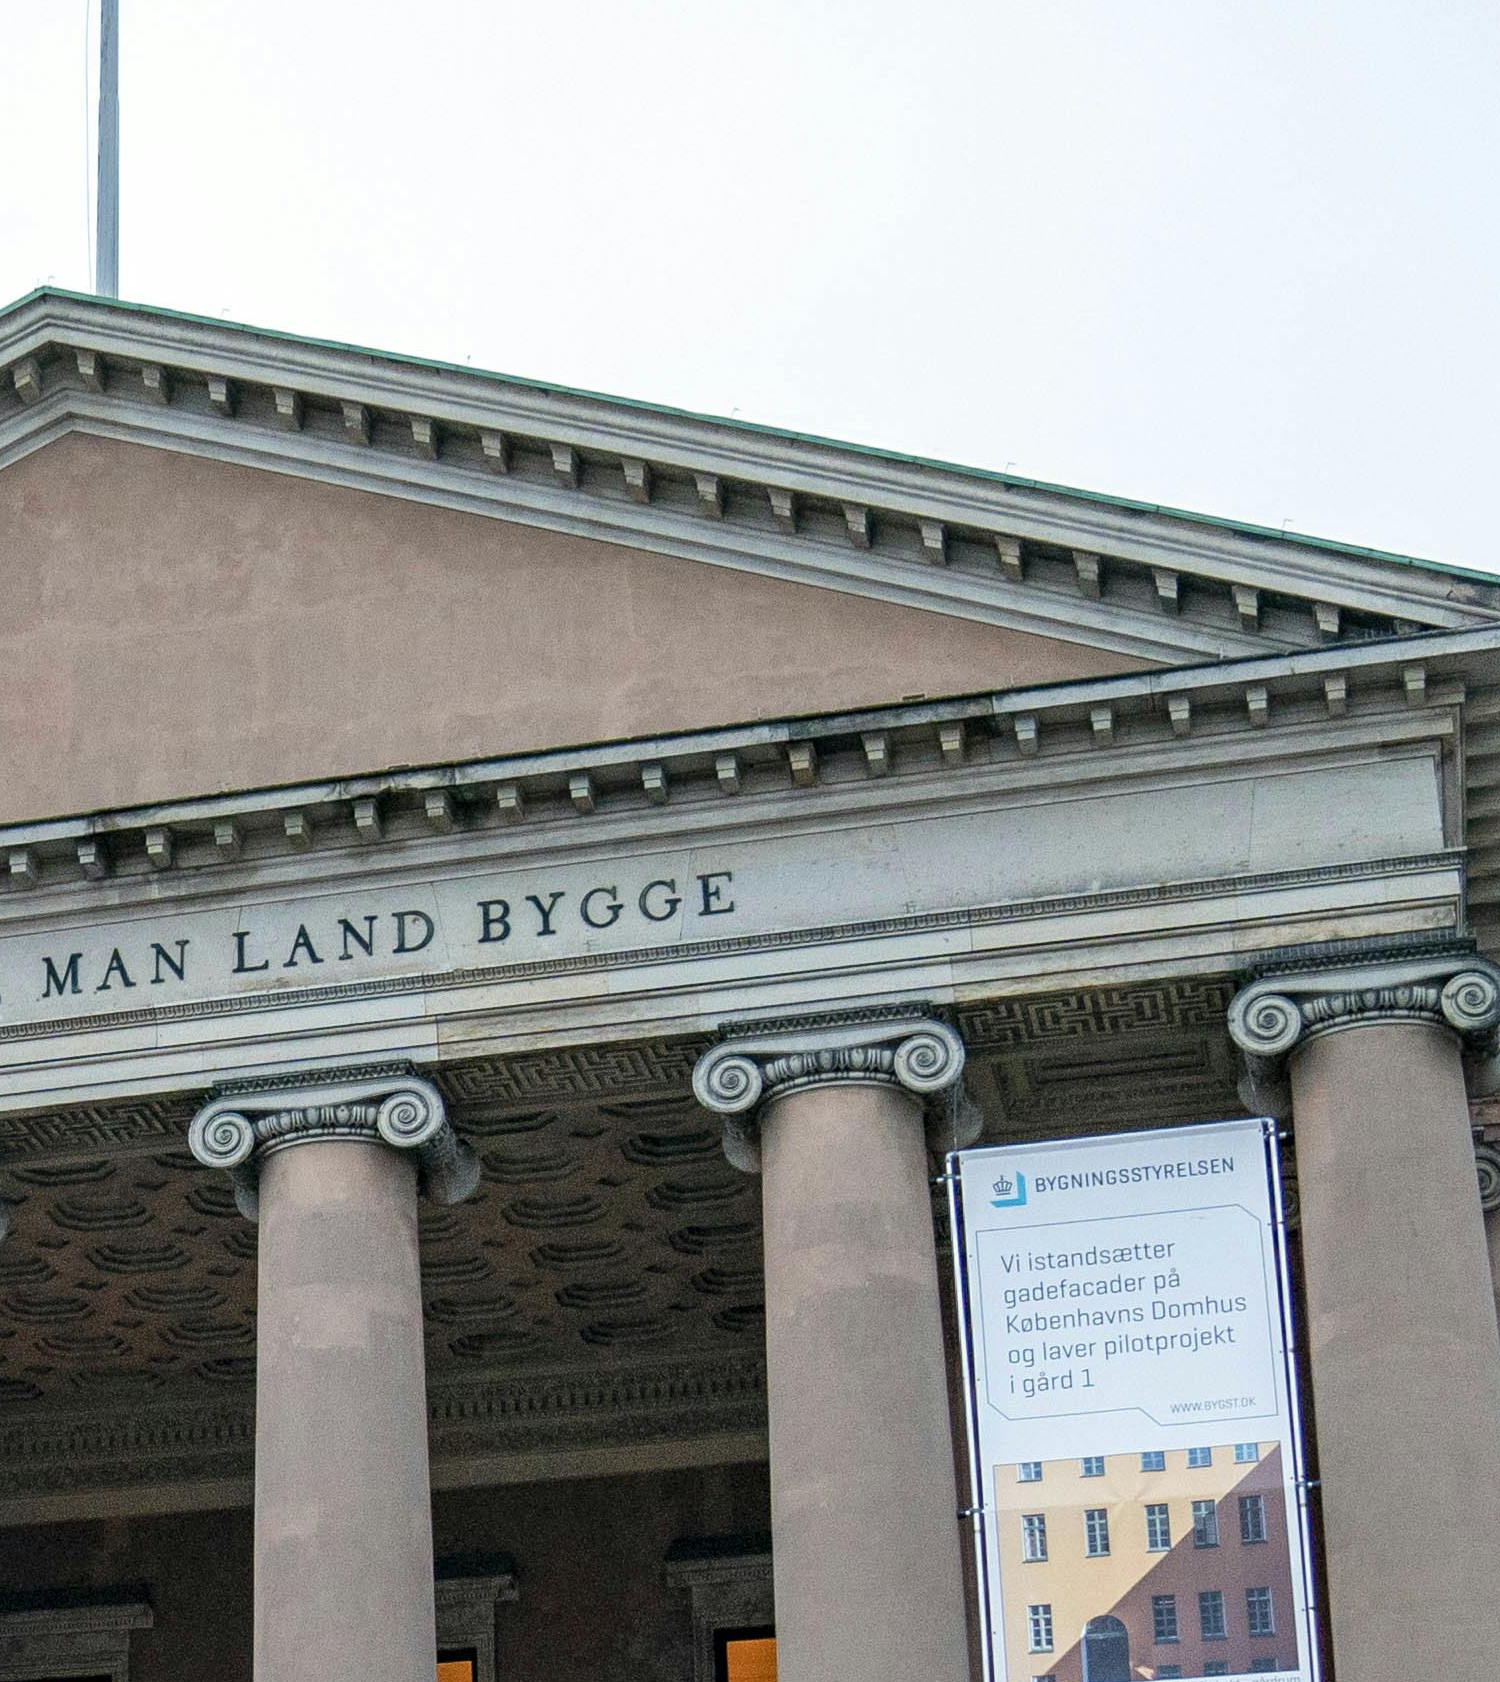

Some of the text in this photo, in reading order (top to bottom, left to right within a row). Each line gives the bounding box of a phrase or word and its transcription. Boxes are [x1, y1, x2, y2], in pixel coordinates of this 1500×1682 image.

[41, 938, 192, 1000] MAN
[233, 909, 437, 975] LAND
[476, 871, 740, 945] BYGGE
[1035, 1157, 1235, 1193] BYGNINGSSTYRELSEN
[1000, 1241, 1176, 1274] Vi istandsætter
[1004, 1267, 1181, 1309] gadefacader på
[1006, 1296, 1248, 1334] Københavns Domhus
[1008, 1325, 1236, 1368] og laver pilotprojekt
[1009, 1368, 1096, 1398] i gård 1
[1169, 1397, 1257, 1414] WWW.BYGST.DK
